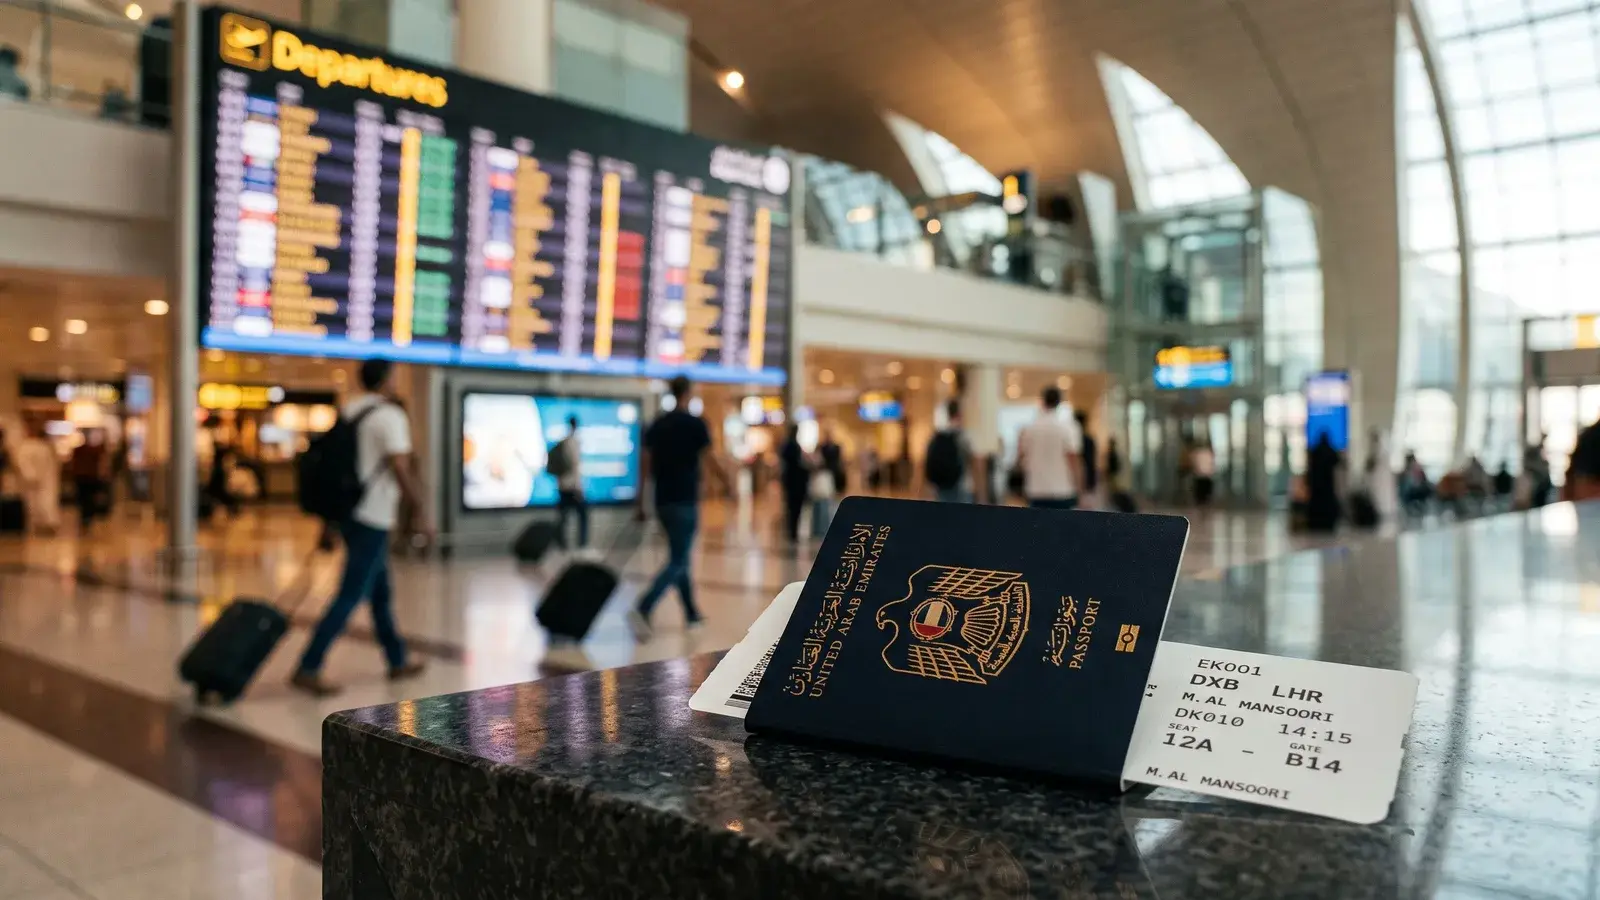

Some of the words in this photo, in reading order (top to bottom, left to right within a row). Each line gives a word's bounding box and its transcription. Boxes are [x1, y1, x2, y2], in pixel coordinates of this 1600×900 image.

[809, 640, 842, 698] UNITED
[838, 597, 862, 637] ARAB
[854, 525, 891, 593] EMIRATES
[1068, 597, 1101, 670] PASSPORT
[1189, 673, 1240, 691] DXB
[1272, 685, 1324, 704] LHR
[1174, 707, 1245, 727] DK010
[1278, 723, 1353, 745] 14:15
[1238, 700, 1334, 723] MANSOORI
[1162, 732, 1213, 752] 12A
[1285, 752, 1343, 774] B14
[1168, 722, 1198, 733] SEAT
[1289, 742, 1322, 753] GATE
[1200, 776, 1291, 800] MANSOORI
